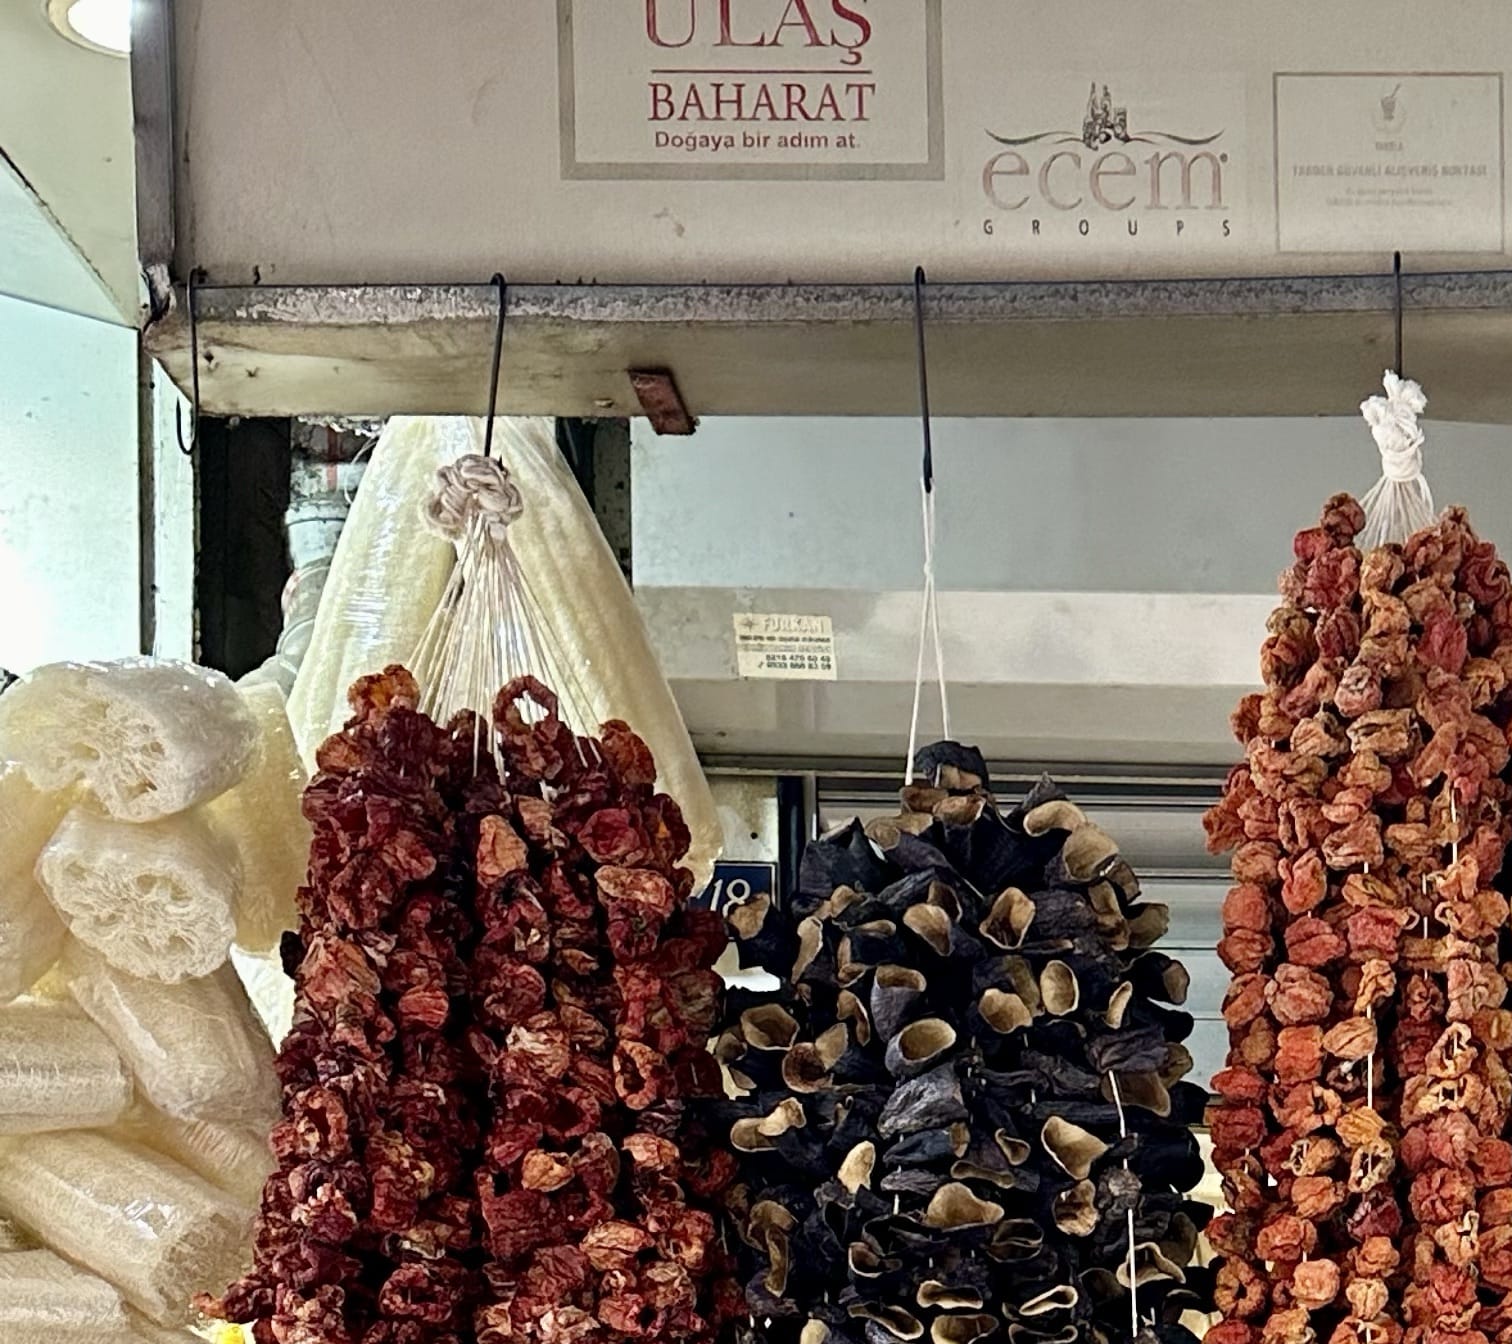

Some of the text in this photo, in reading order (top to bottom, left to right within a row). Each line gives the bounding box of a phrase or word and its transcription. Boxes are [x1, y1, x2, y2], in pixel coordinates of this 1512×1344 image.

[648, 83, 876, 121] BAHARAT
[655, 131, 735, 151] Doğaya
[743, 131, 770, 148] bir
[778, 132, 829, 148] adım
[983, 151, 1228, 210] ecem
[984, 219, 1231, 236] GROUPS
